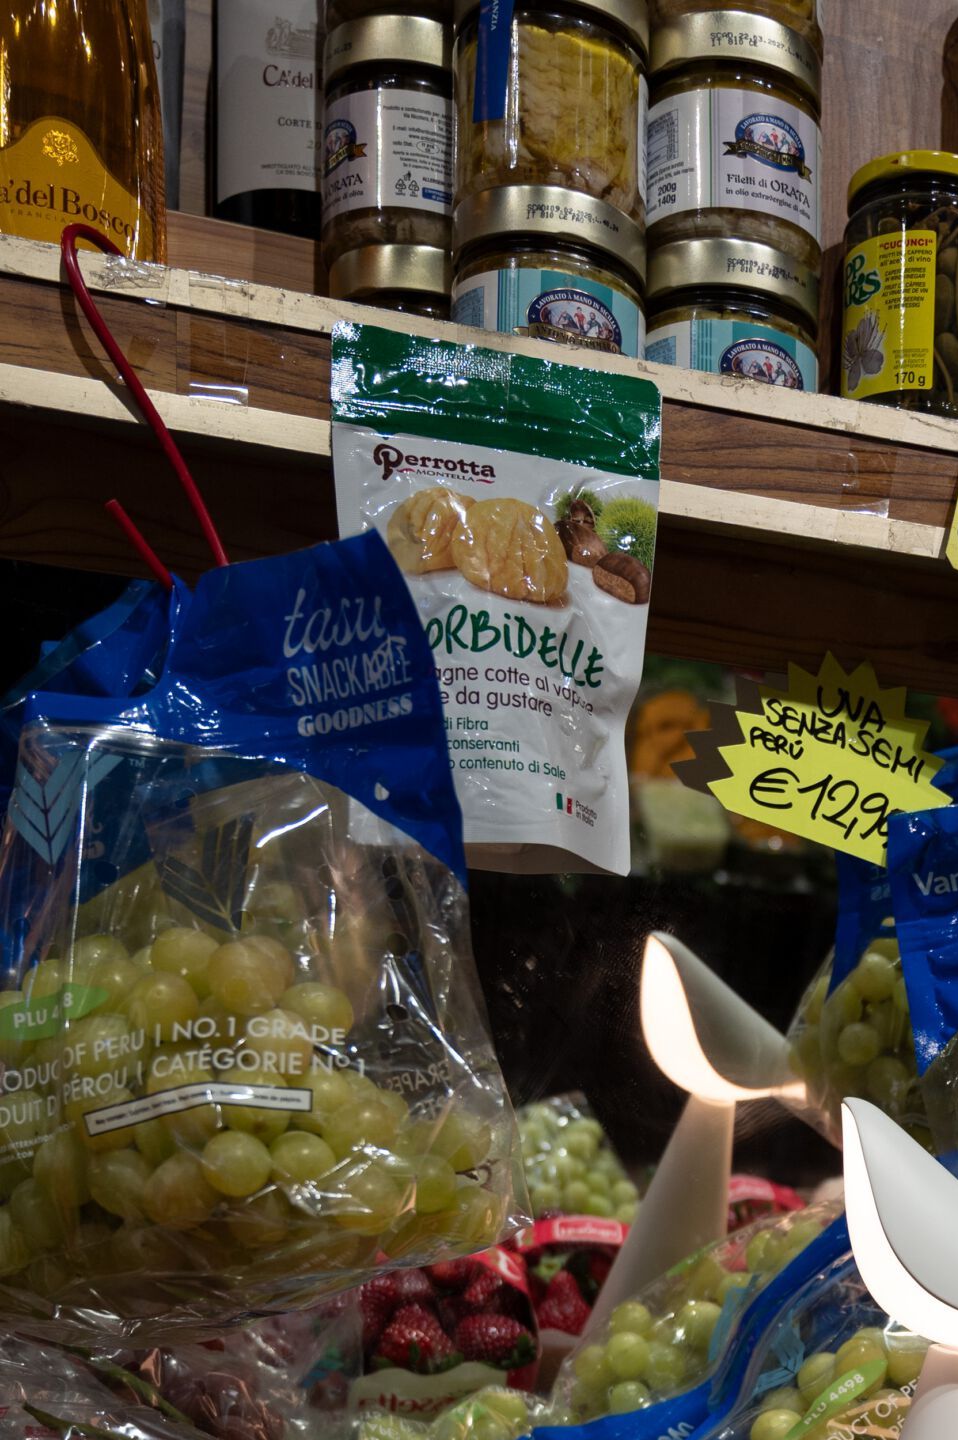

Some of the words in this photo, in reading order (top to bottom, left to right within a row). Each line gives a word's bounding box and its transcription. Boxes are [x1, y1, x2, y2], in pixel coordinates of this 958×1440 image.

[278, 116, 312, 129] CORTE
[657, 182, 677, 197] 200g
[726, 173, 756, 186] Filetti
[758, 177, 768, 188] di
[770, 180, 811, 208] ORATA
[726, 187, 734, 195] in
[735, 188, 750, 197] olio
[0, 179, 55, 210] a'del
[61, 186, 136, 242] Bosco
[536, 292, 567, 309] LAVORATO
[573, 294, 593, 306] MANO
[600, 305, 617, 329] SICILIA
[727, 343, 757, 359] LAVORATO
[762, 344, 779, 356] MANO
[894, 371, 915, 384] 170
[918, 374, 926, 387] g
[373, 443, 497, 481] Perrotta
[416, 468, 475, 483] MONTELLA
[287, 650, 413, 706] SNACKABLE
[484, 666, 530, 686] cotte
[535, 675, 550, 692] al
[297, 693, 413, 737] GOODNESS
[456, 689, 480, 705] da
[487, 691, 553, 717] gustare
[816, 685, 886, 733] UVA
[457, 717, 489, 731] Fibra
[764, 698, 846, 749] SENZA
[849, 729, 925, 784] SEMI
[459, 757, 525, 772] contenuto
[528, 760, 540, 773] di
[543, 762, 566, 780] Sale
[13, 1008, 47, 1029] PLU
[93, 1029, 145, 1061] PERU
[246, 1016, 346, 1047] GRADE
[63, 1066, 128, 1104] PÉROU
[151, 1045, 304, 1079] CATÉGORIE
[803, 1402, 828, 1426] PLU
[829, 1373, 865, 1401] 4498
[875, 1395, 899, 1419] OF
